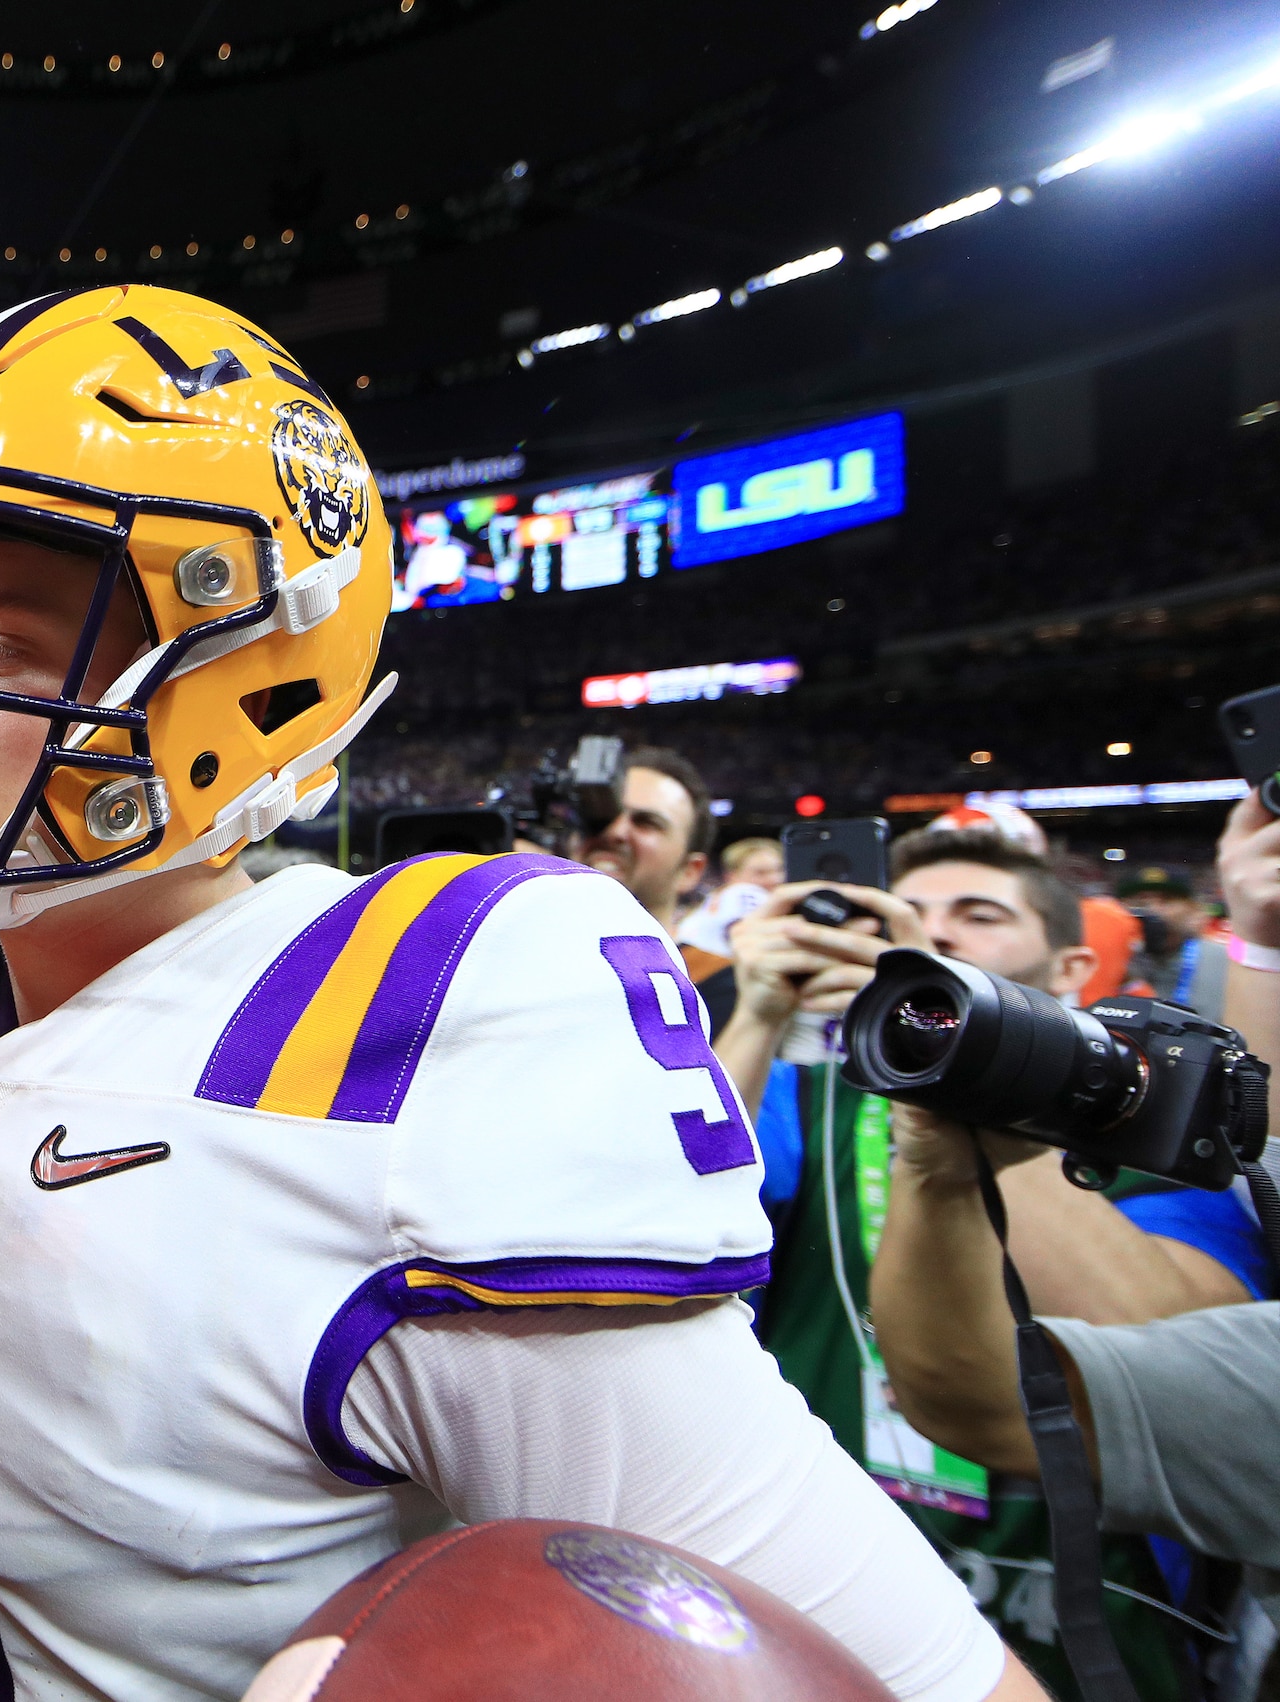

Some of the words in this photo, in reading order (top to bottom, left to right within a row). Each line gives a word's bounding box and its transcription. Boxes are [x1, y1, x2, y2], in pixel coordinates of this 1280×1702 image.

[696, 448, 874, 535] LSU
[1091, 1006, 1139, 1019] SONY
[599, 935, 757, 1176] 9
[1089, 1041, 1106, 1056] G
